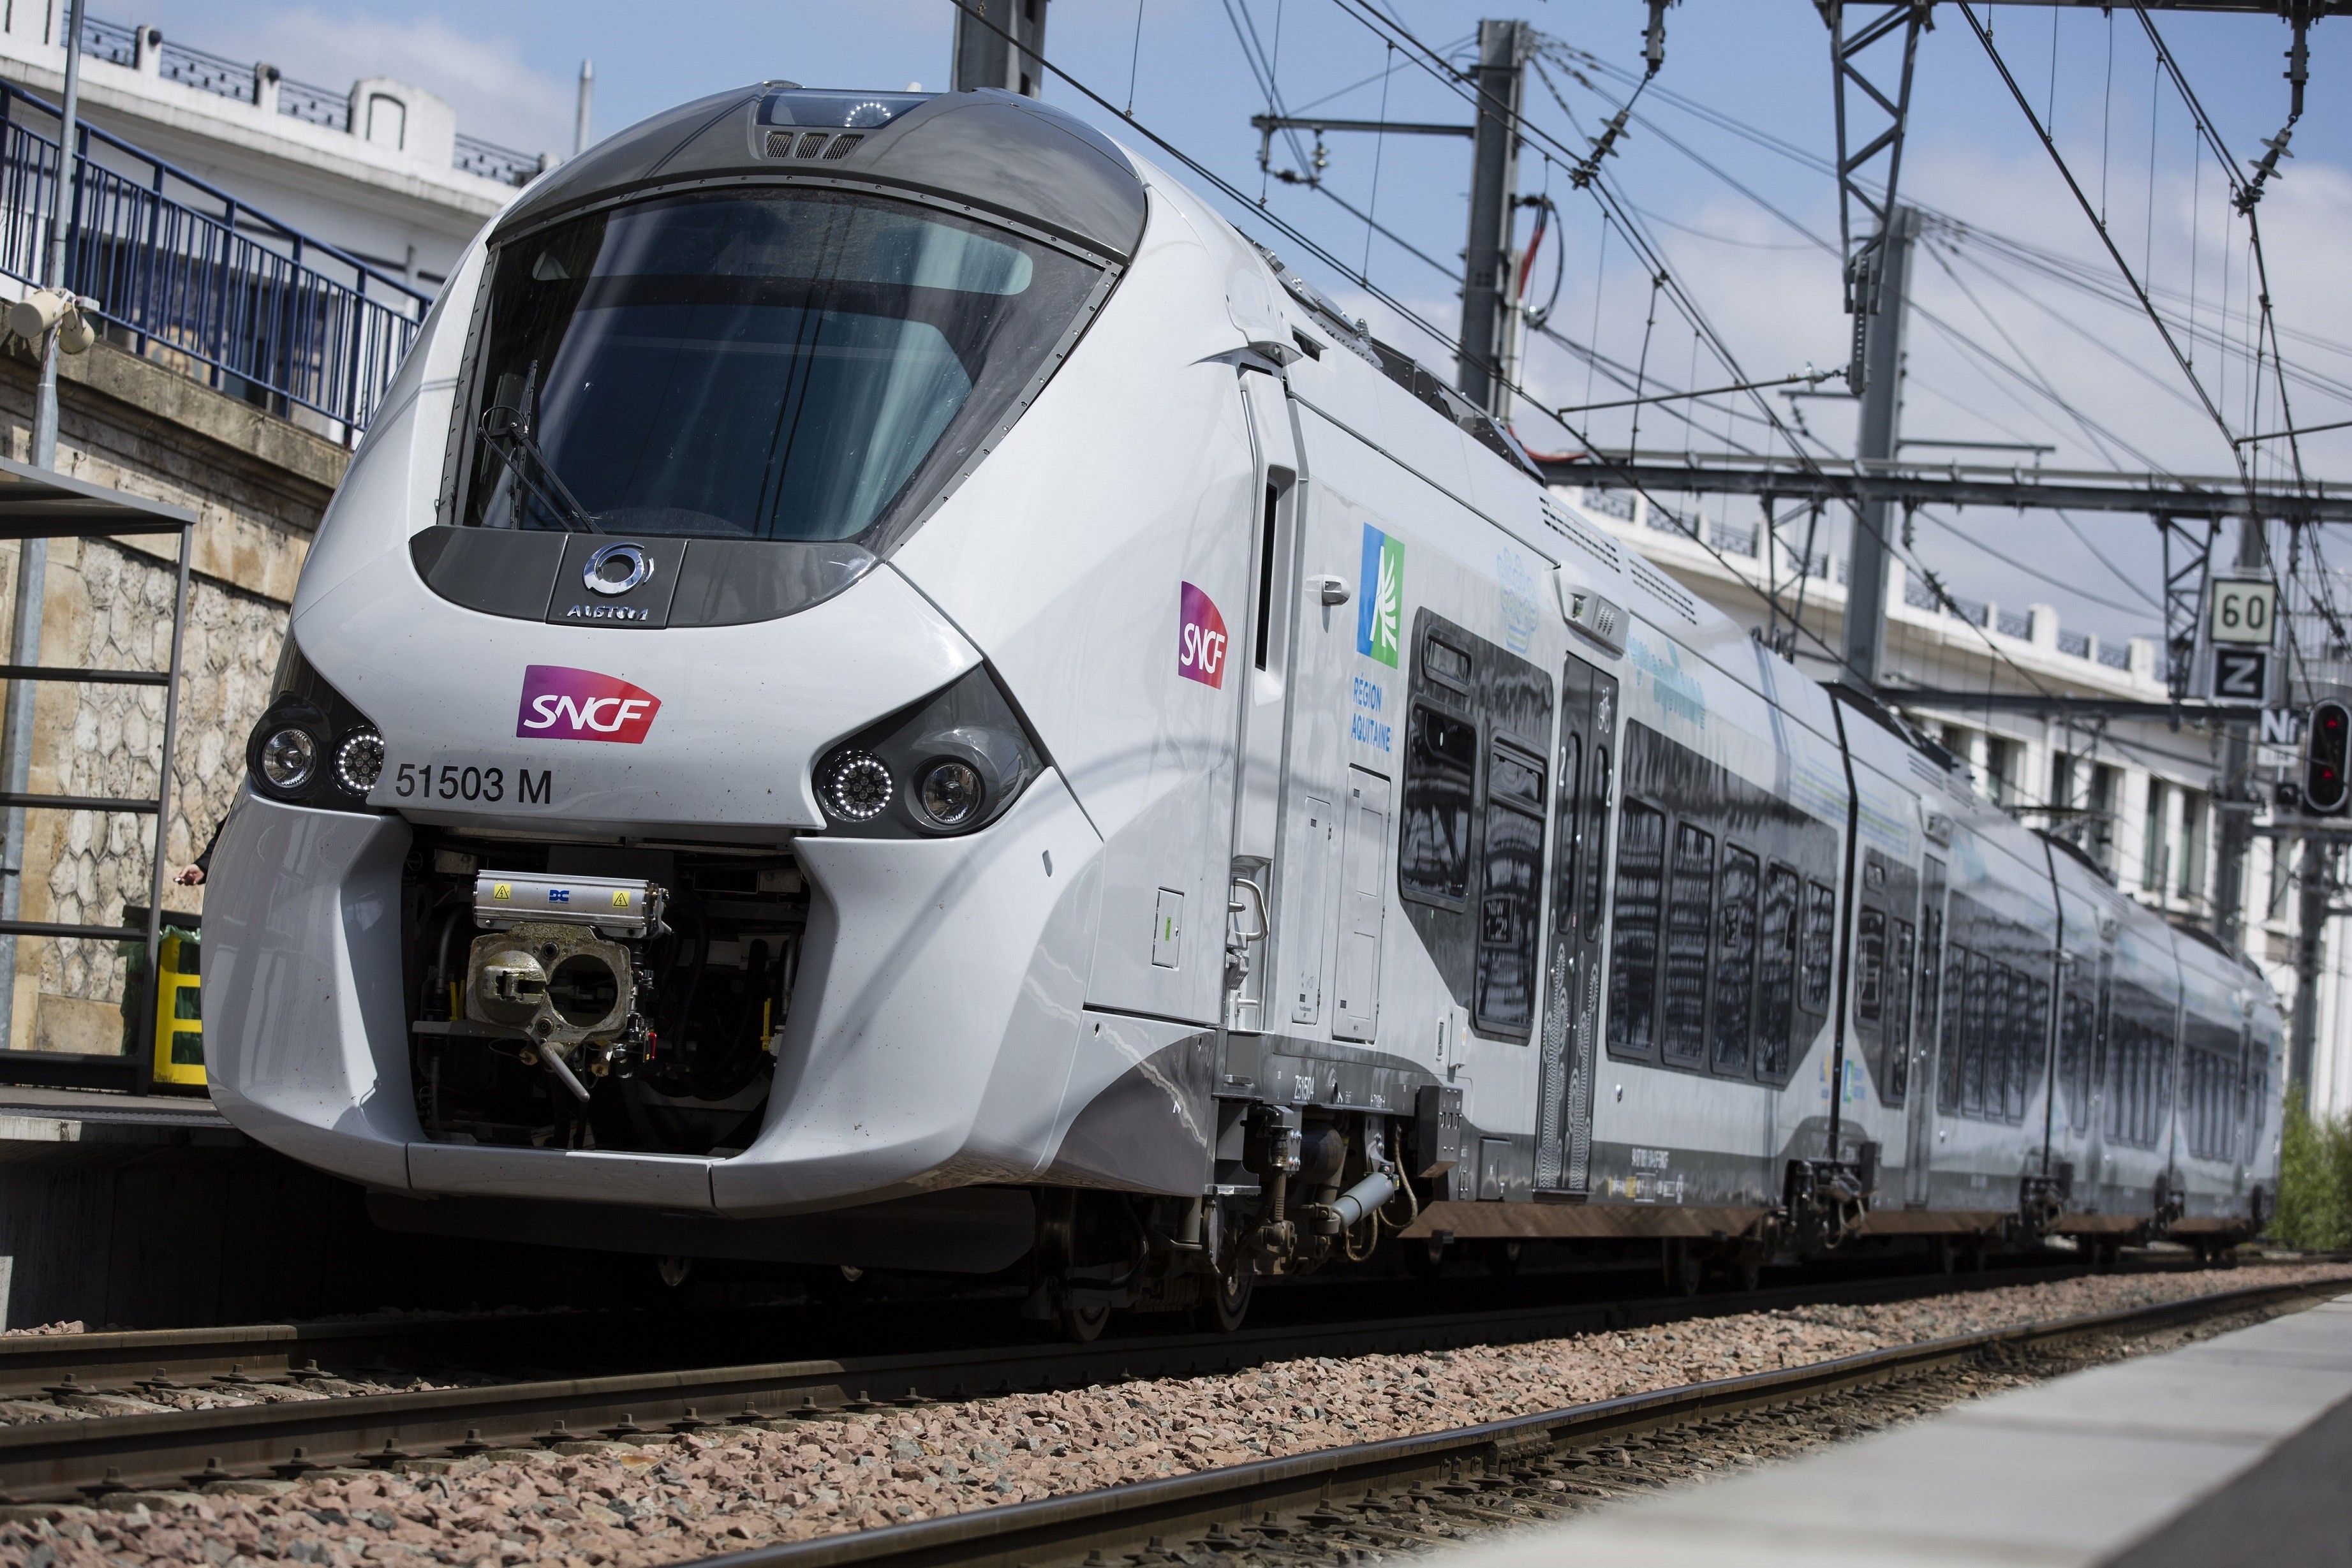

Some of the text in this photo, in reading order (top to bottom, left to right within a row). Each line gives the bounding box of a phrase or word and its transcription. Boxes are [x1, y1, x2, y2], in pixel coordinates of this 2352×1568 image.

[2222, 594, 2265, 630] 60
[1180, 623, 1225, 674] SNCF
[1353, 672, 1382, 713] RÉGION
[2223, 656, 2257, 693] Z
[523, 695, 651, 732] SNCF
[1351, 713, 1391, 752] AQUITAINE
[396, 763, 552, 804] 51503 M
[1558, 746, 1566, 787] 2
[1606, 768, 1613, 807] 2
